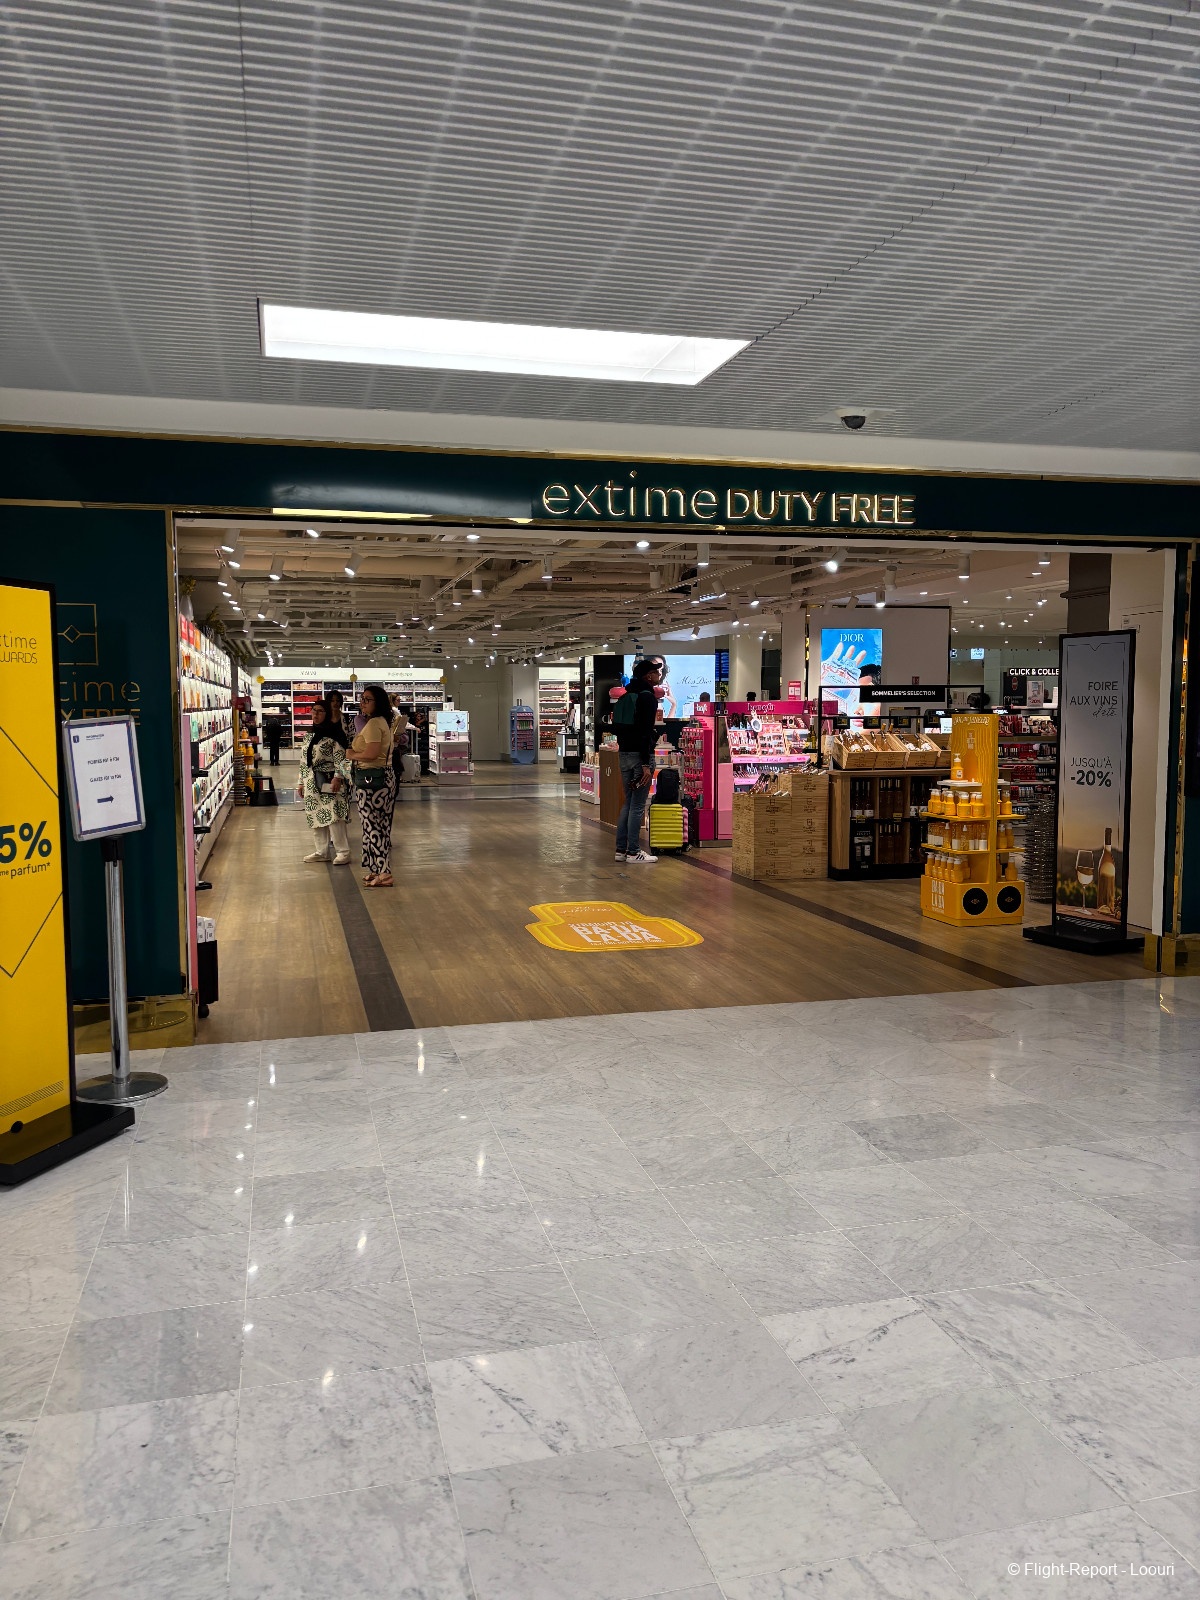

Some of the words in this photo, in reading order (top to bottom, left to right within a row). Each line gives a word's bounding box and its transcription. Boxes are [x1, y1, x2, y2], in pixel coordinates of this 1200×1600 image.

[542, 470, 719, 519] extime
[727, 488, 826, 521] DUTY
[831, 492, 917, 524] FREE
[840, 633, 865, 643] DIOR
[1088, 681, 1119, 691] FOIRE
[1070, 695, 1091, 706] AUX
[1093, 695, 1118, 706] VINS
[1070, 756, 1113, 769] JUSQU'À
